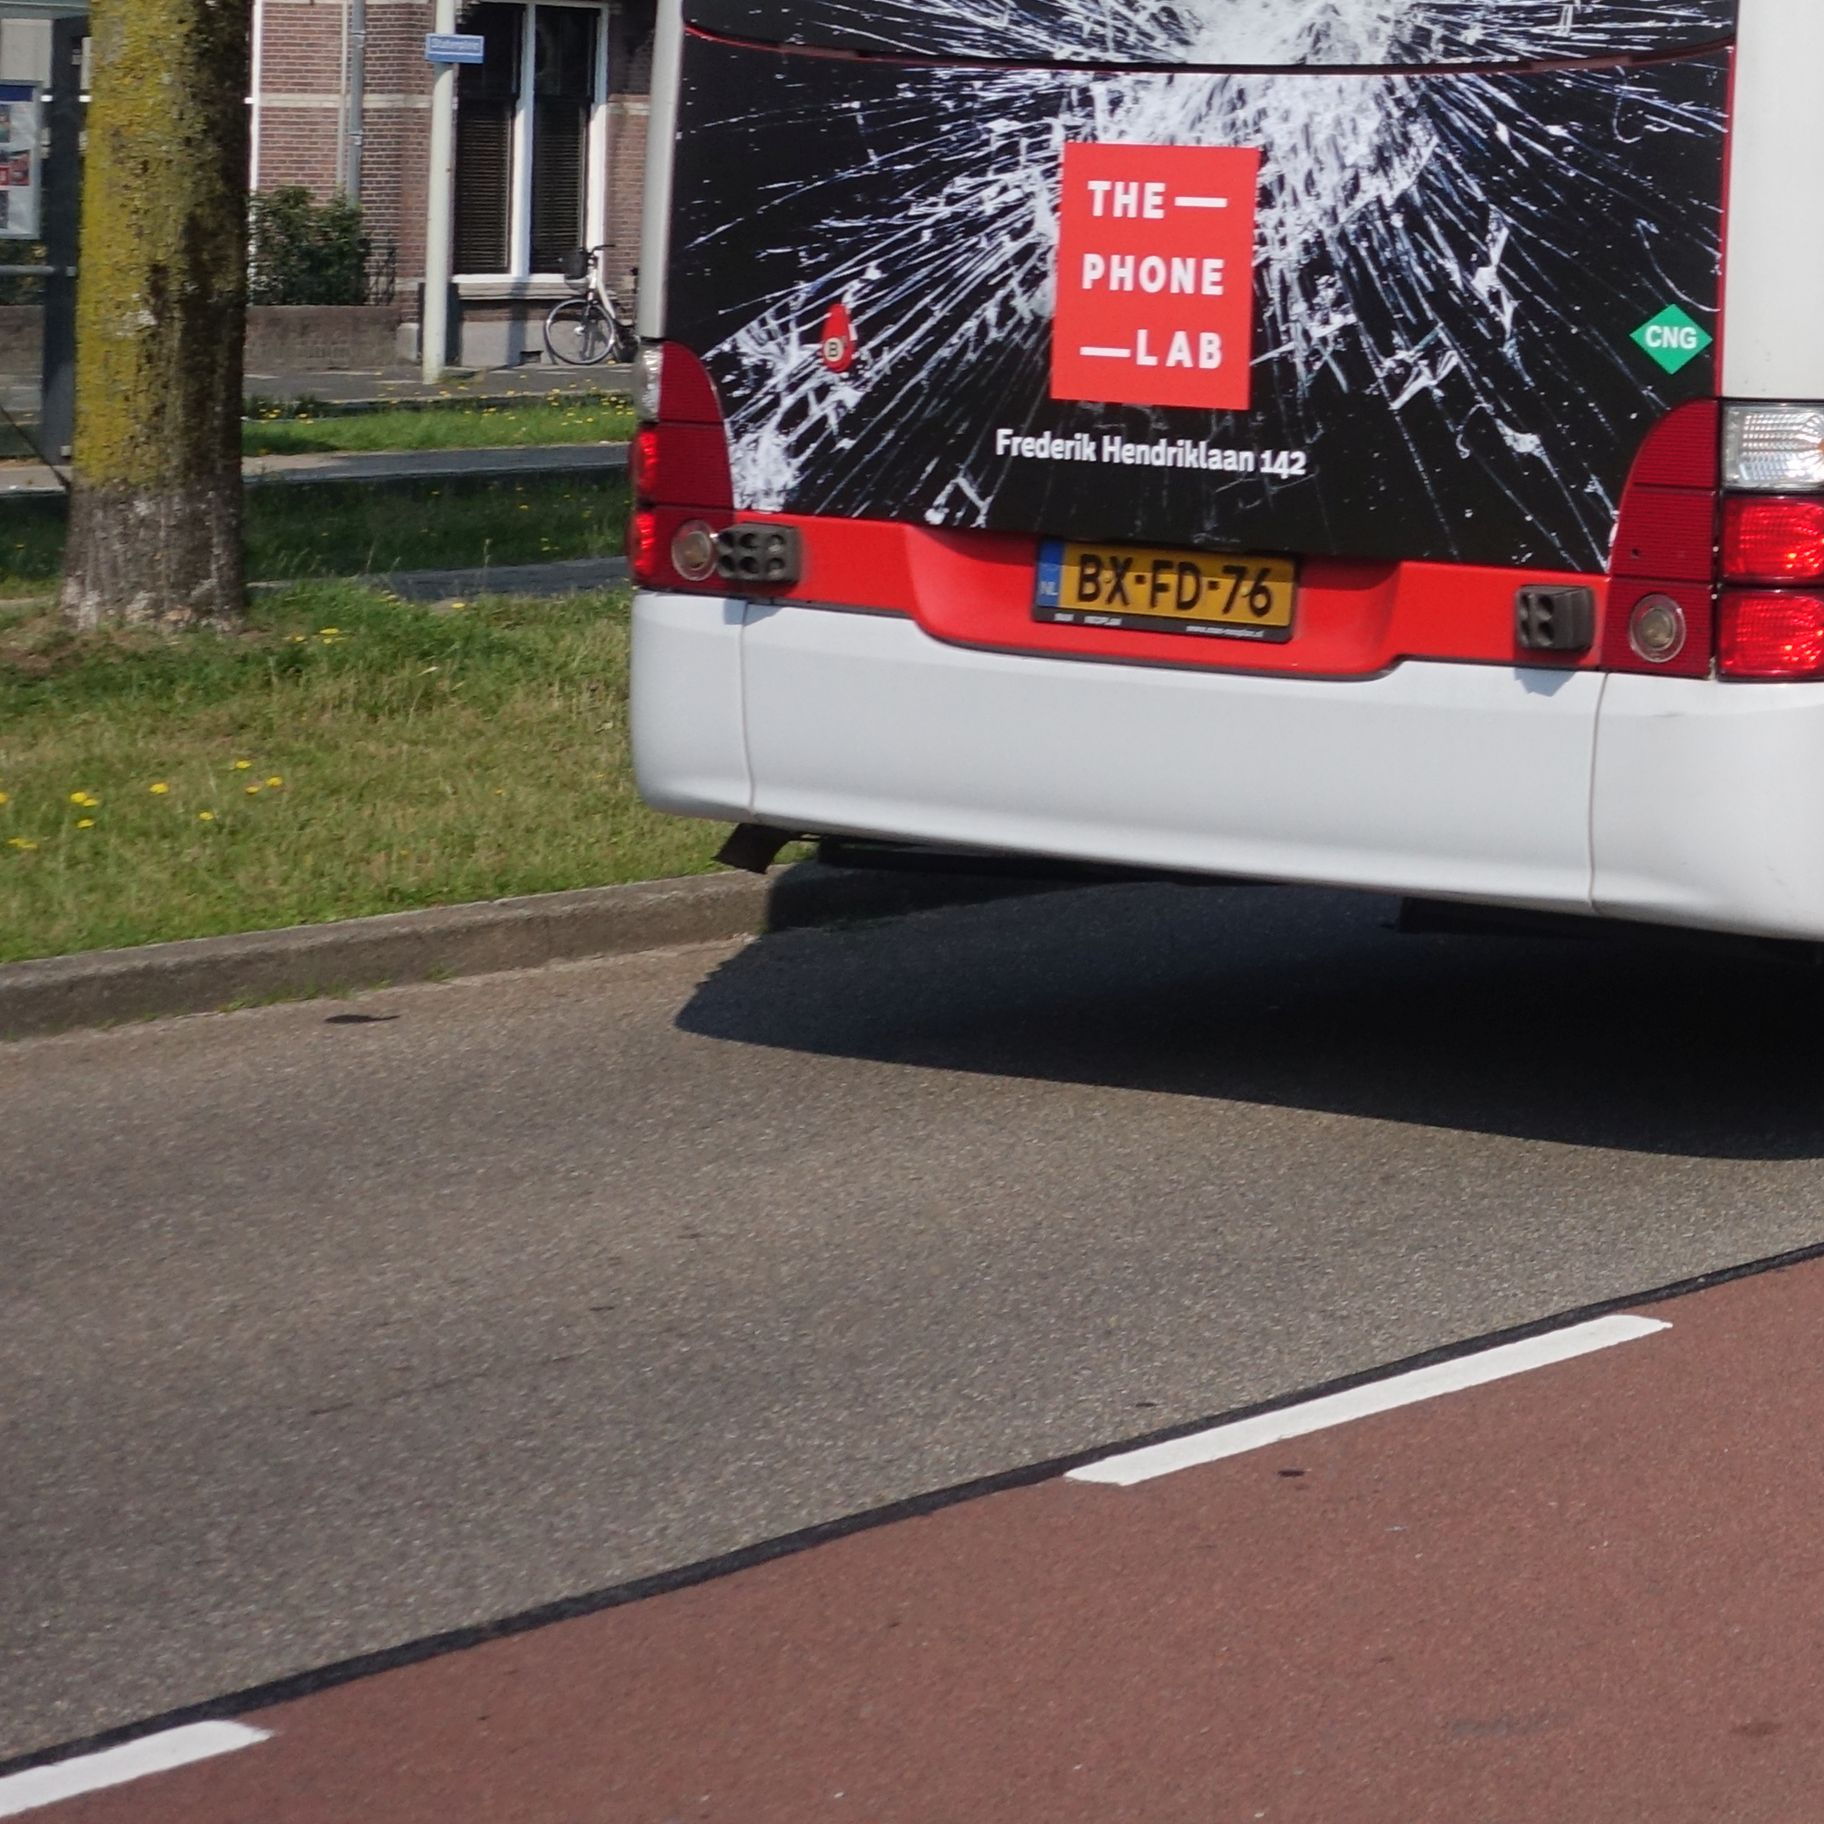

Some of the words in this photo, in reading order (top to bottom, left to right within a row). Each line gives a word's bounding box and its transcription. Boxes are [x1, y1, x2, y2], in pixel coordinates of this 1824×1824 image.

[1087, 180, 1166, 219] THE
[1082, 253, 1225, 296] PHONE
[1136, 329, 1223, 370] LAB
[1645, 324, 1698, 349] CNG
[996, 428, 1098, 462] Frederik
[1102, 434, 1255, 472] Hendriklaan
[1260, 448, 1307, 480] 142
[1040, 580, 1059, 596] NL
[1076, 552, 1273, 618] BX-FD-76
